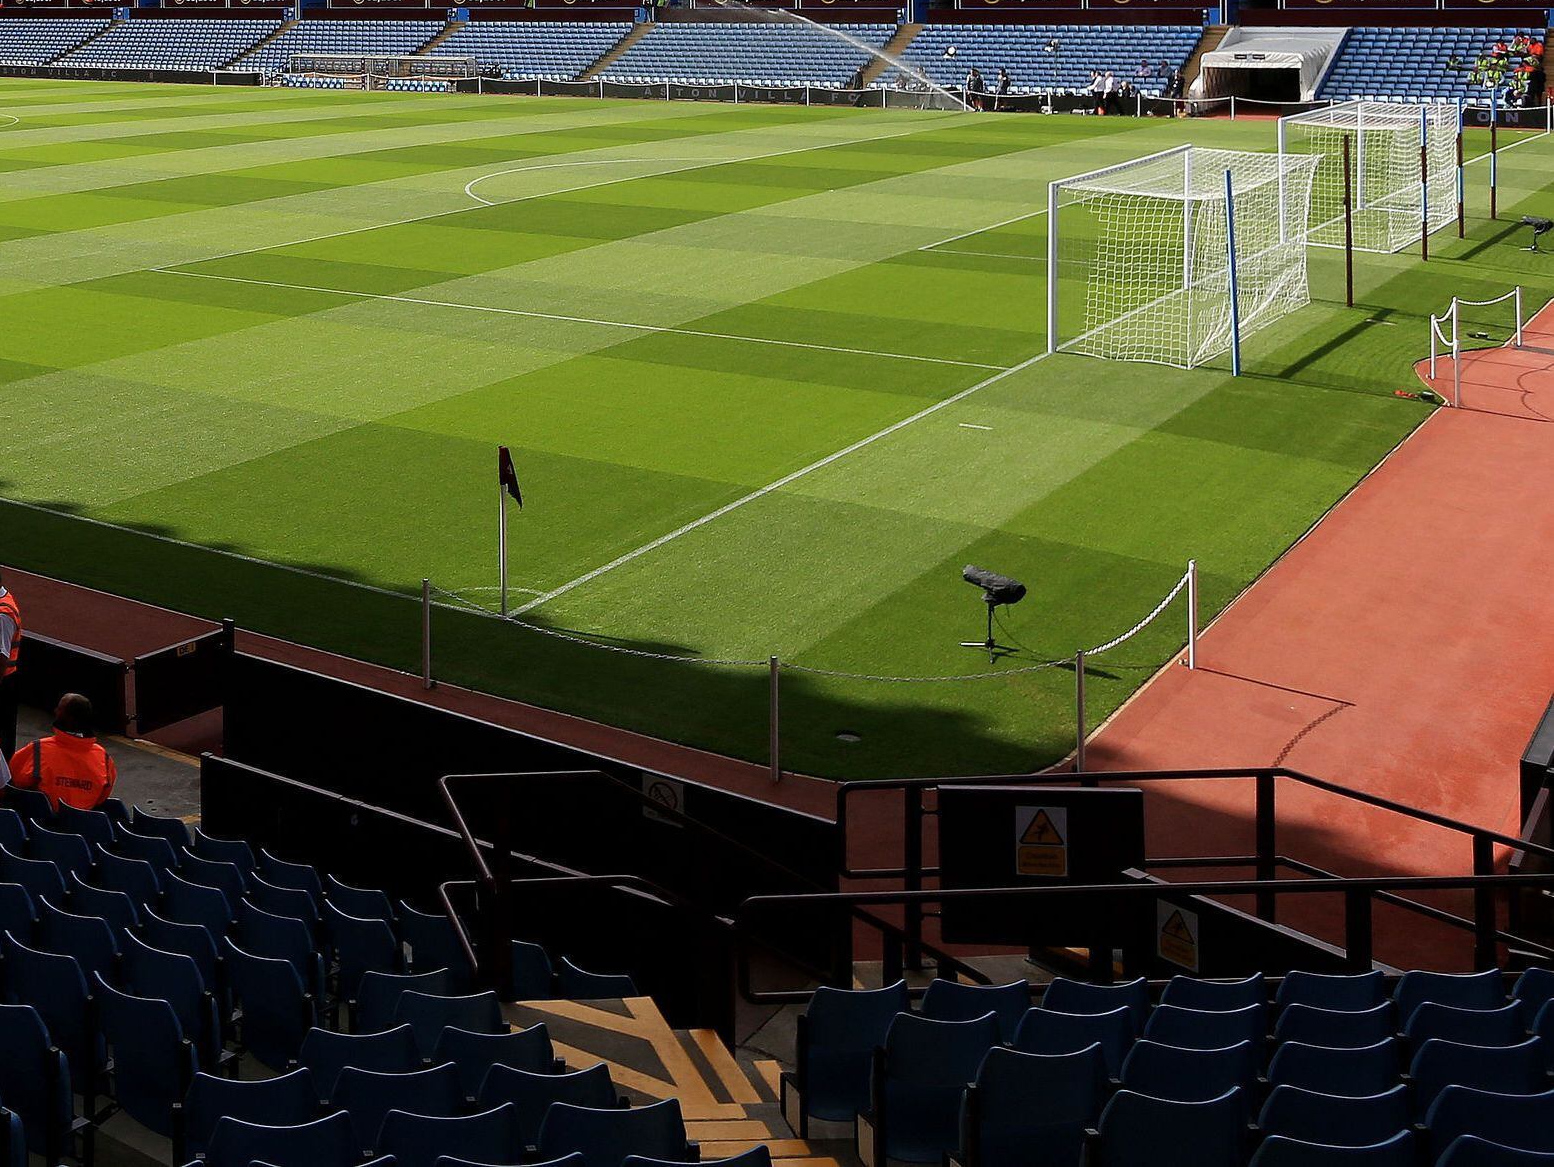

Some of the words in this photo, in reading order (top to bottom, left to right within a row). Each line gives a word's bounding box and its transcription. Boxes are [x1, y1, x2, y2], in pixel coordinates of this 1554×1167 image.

[47, 69, 90, 77] VILLA
[101, 70, 117, 78] FC
[644, 87, 717, 97] ASTON
[737, 89, 807, 101] VILLA
[54, 776, 93, 791] STEWARD
